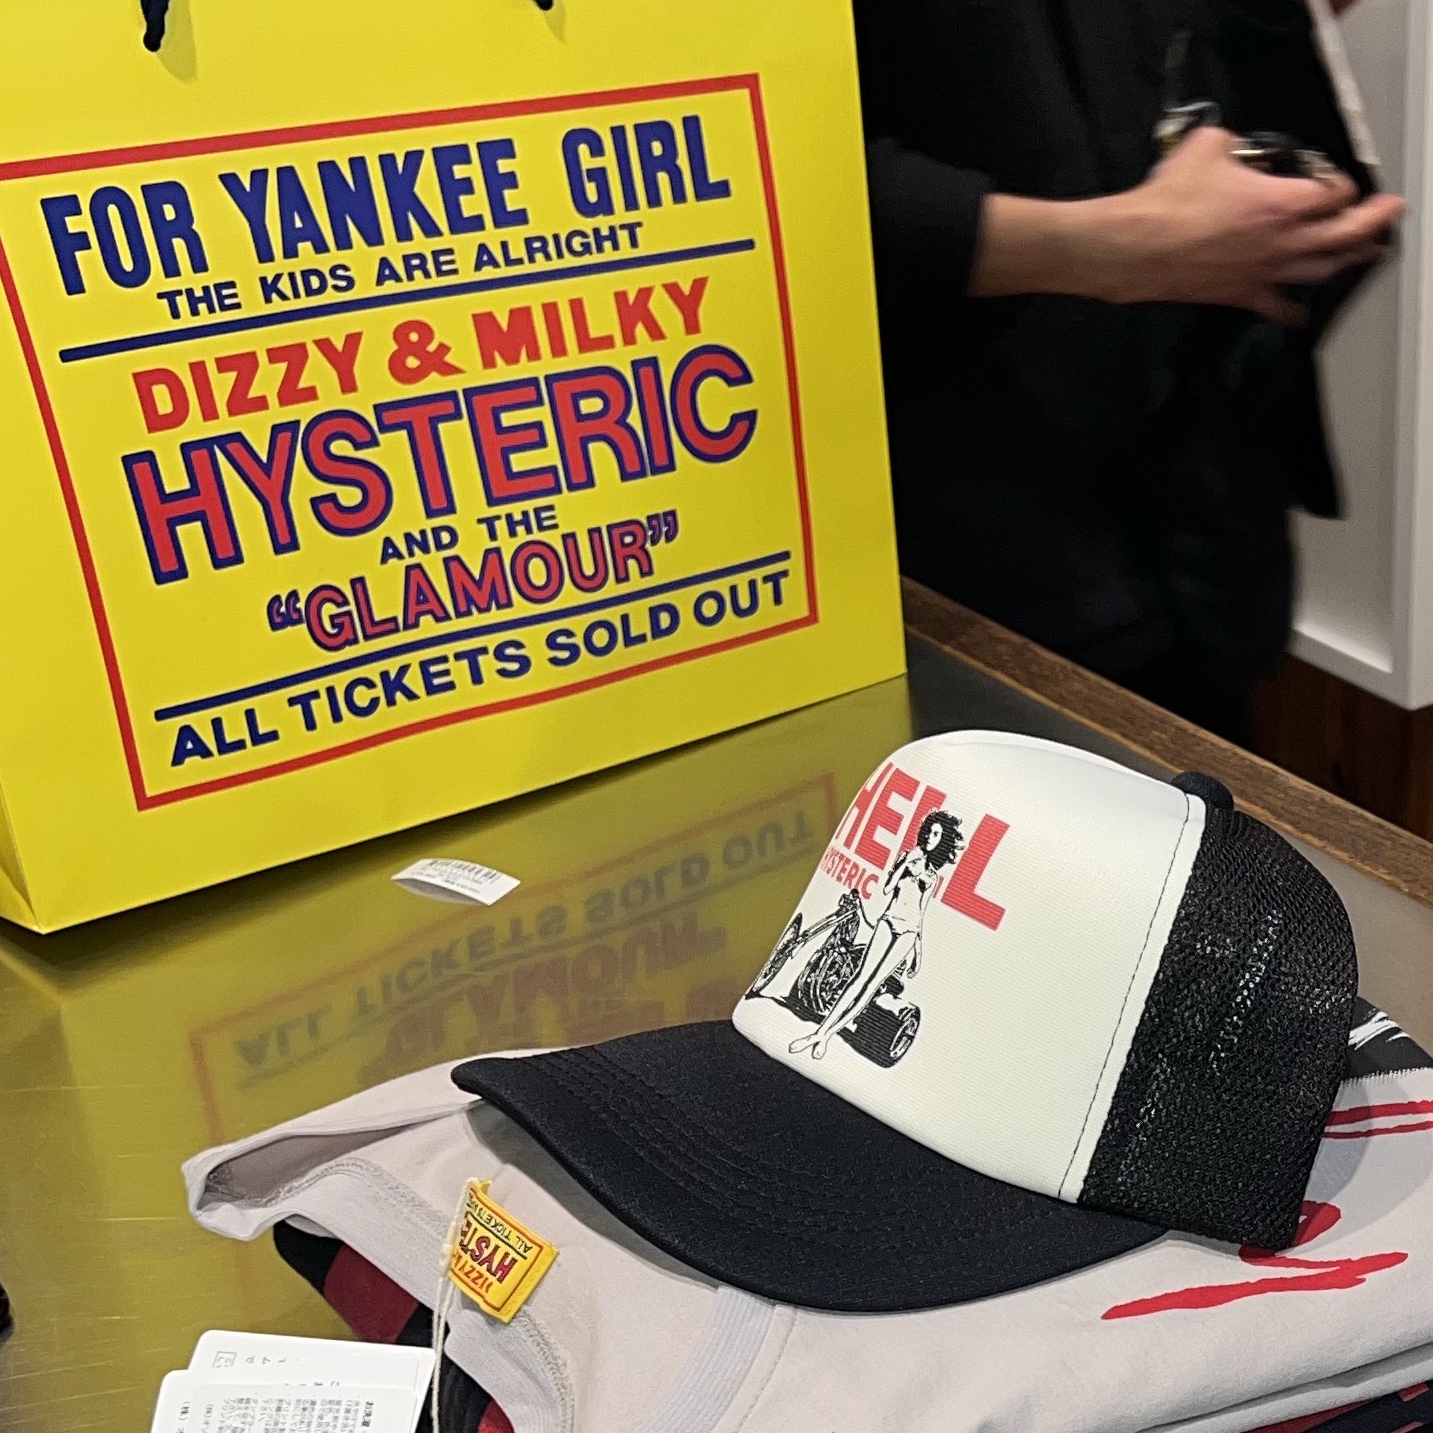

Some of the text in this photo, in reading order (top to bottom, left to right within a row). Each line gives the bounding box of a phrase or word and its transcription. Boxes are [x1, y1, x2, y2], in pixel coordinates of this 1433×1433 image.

[41, 115, 731, 295] FOR YANKEE GIRL
[158, 222, 645, 320] THE KIDS ARE ALRIGHT
[132, 276, 710, 434] DIZZY & MILKY
[122, 343, 759, 586] HYSTERIC
[380, 506, 559, 566] AND THE
[267, 510, 679, 650] “GLAMOUR”
[171, 568, 793, 768] ALL TICKETS SOLD OUT
[516, 1236, 533, 1254] ALL
